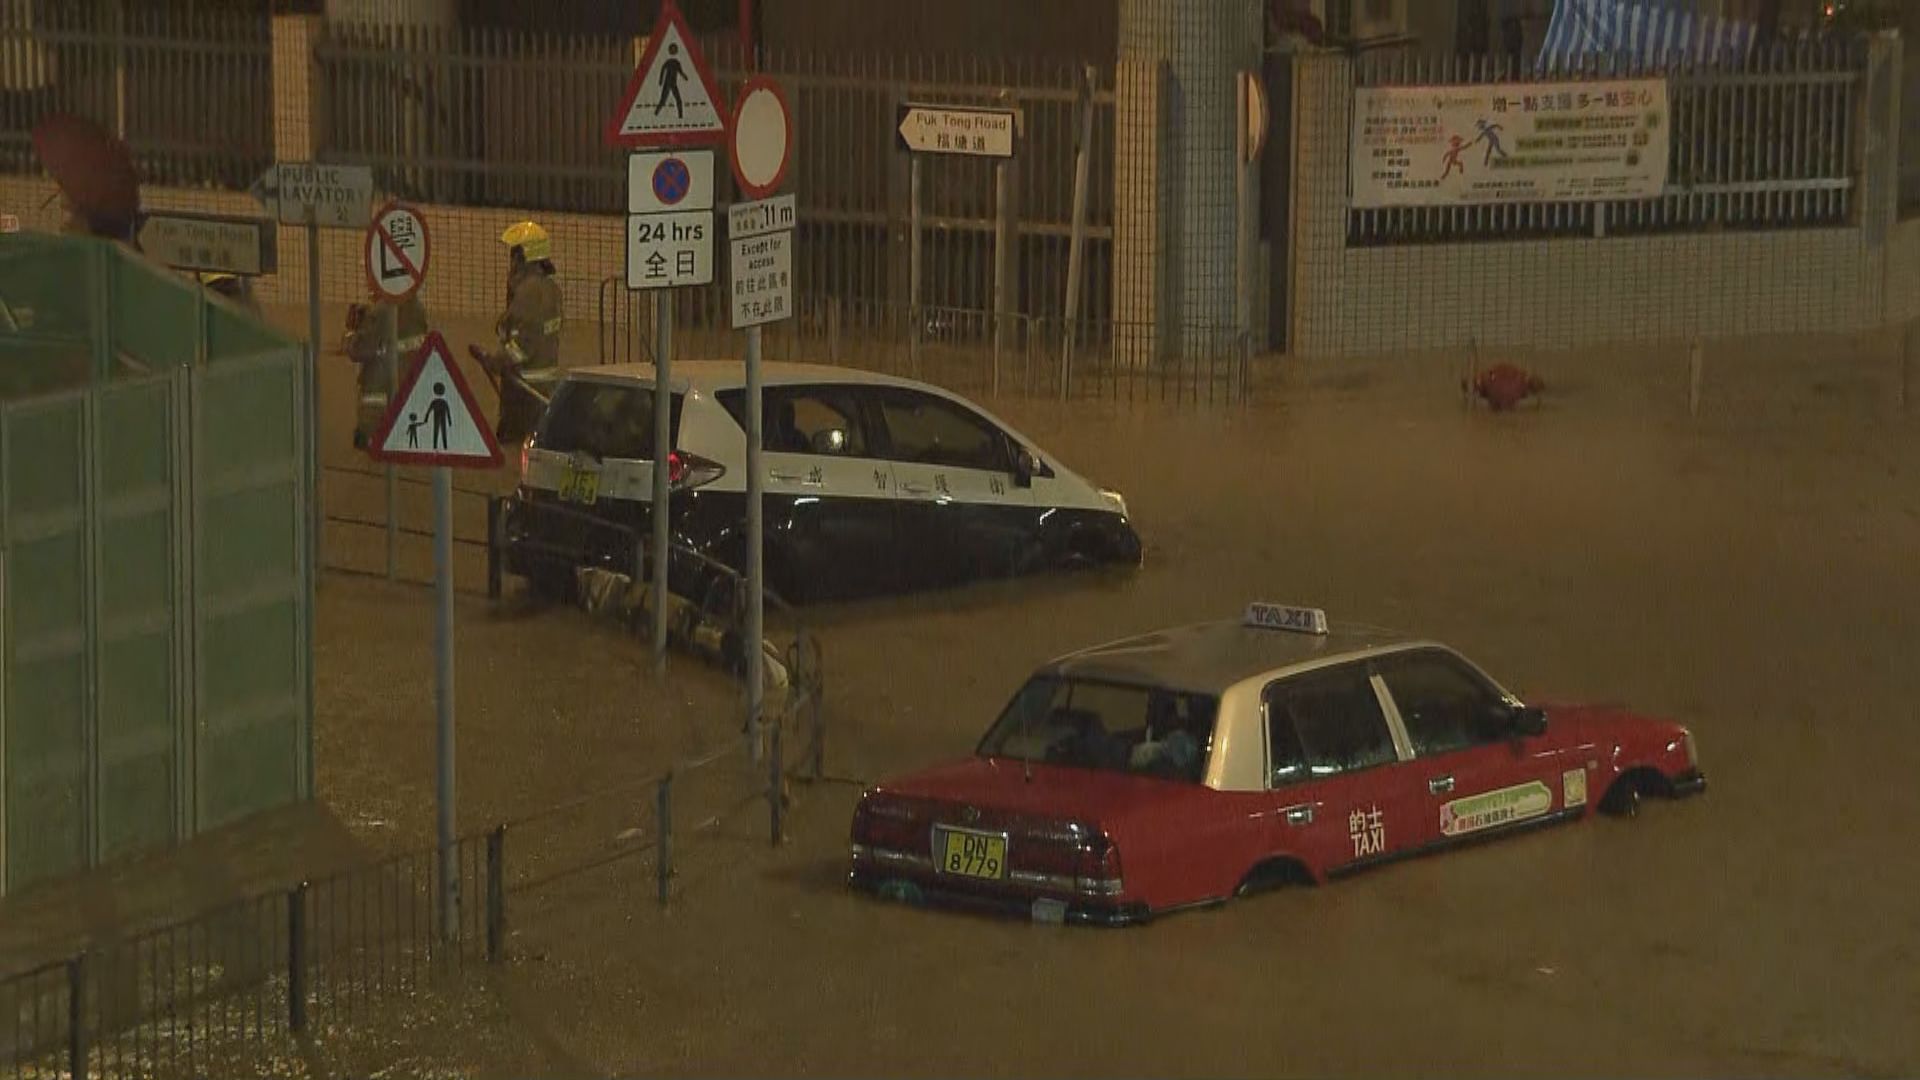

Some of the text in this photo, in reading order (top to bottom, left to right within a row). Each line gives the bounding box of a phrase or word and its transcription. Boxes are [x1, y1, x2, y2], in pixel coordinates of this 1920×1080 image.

[916, 112, 1006, 131] Fuk Tong Road
[282, 167, 339, 185] PUBLIC
[282, 186, 364, 202] LAVATORY
[780, 205, 793, 220] m
[638, 221, 703, 243] 24 hrs
[741, 239, 782, 256] Except for
[645, 250, 695, 279] 全日
[749, 256, 775, 270] access
[1251, 605, 1315, 627] TAXI
[1349, 803, 1383, 832] 的士
[964, 836, 988, 860] DN
[1351, 828, 1385, 857] TAXI
[950, 853, 998, 878] 8779
